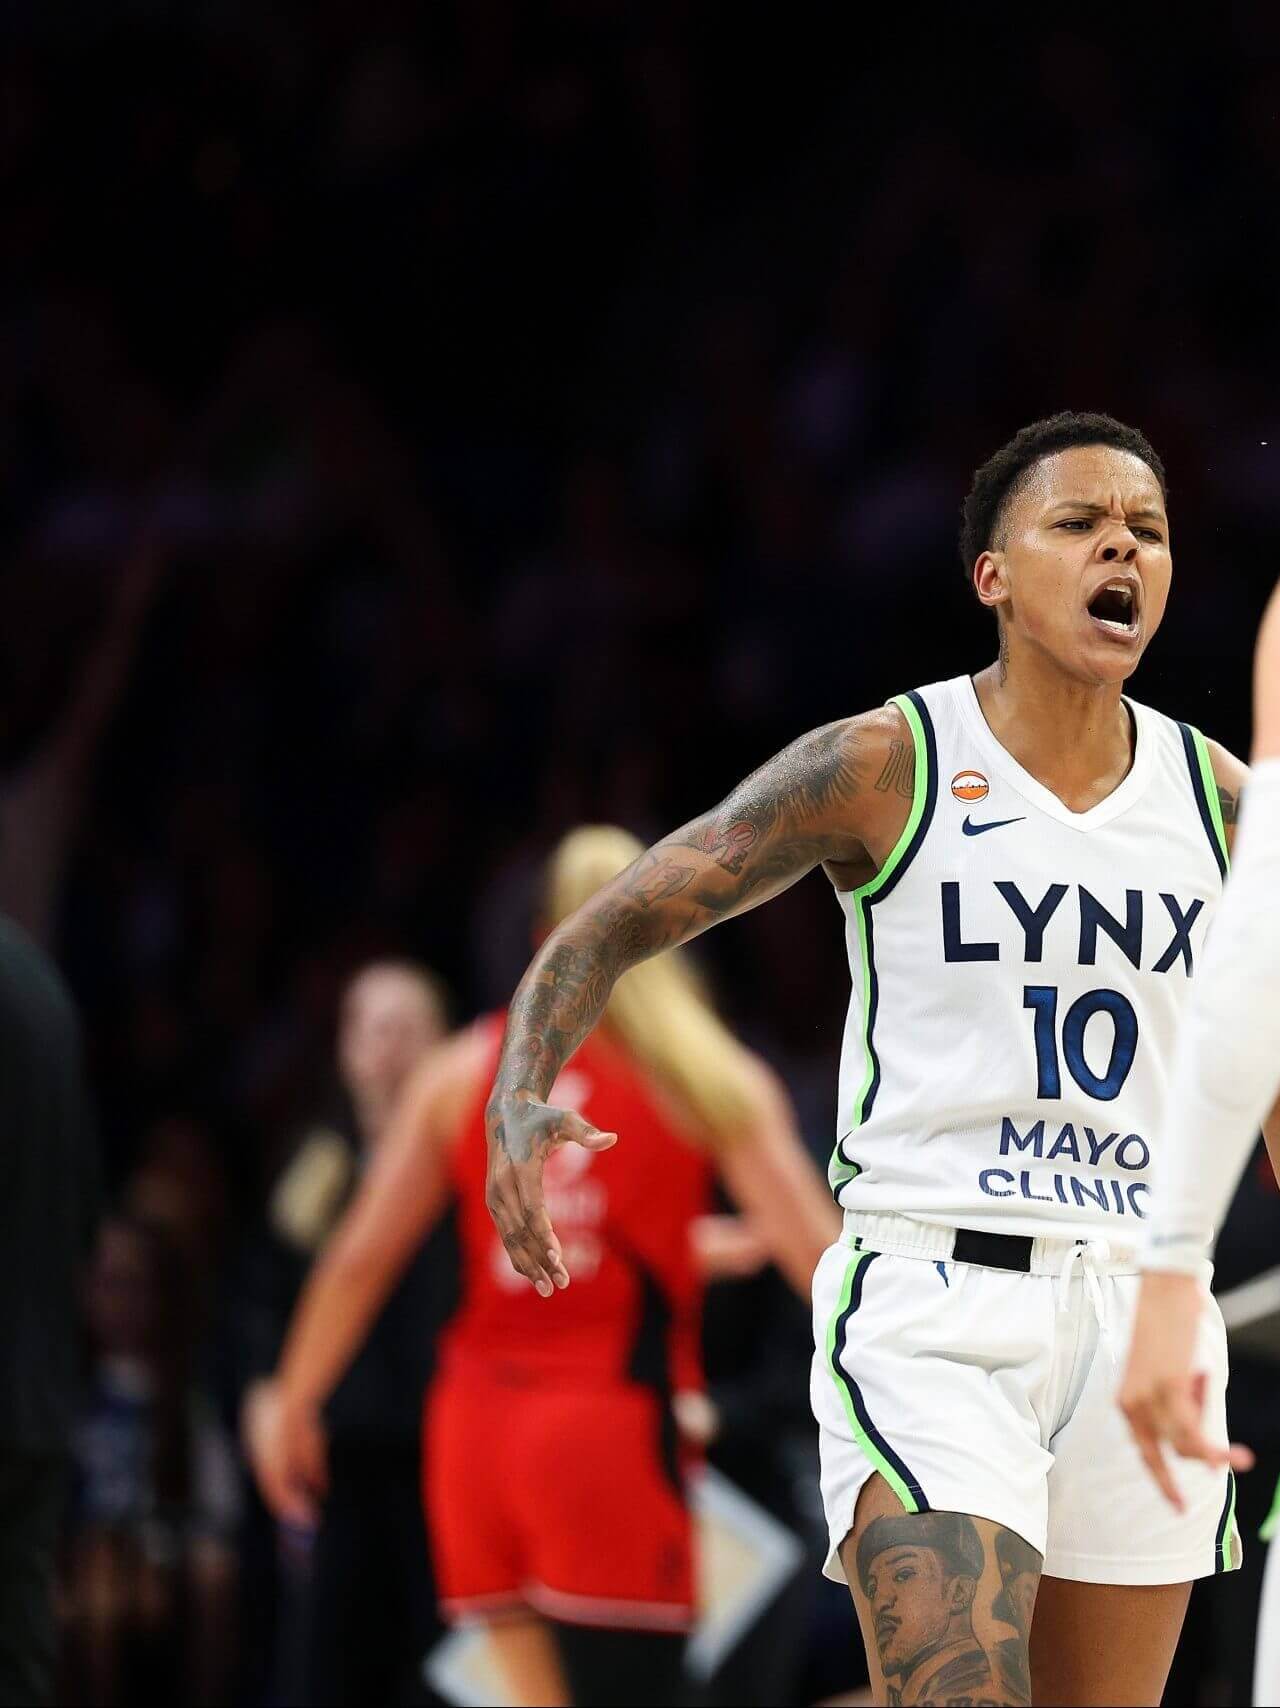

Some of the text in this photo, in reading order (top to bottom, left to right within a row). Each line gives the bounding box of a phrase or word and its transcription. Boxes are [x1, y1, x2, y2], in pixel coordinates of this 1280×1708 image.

[940, 880, 1205, 978] LYNX
[1022, 985, 1139, 1102] 10
[998, 1116, 1150, 1171] MAYO
